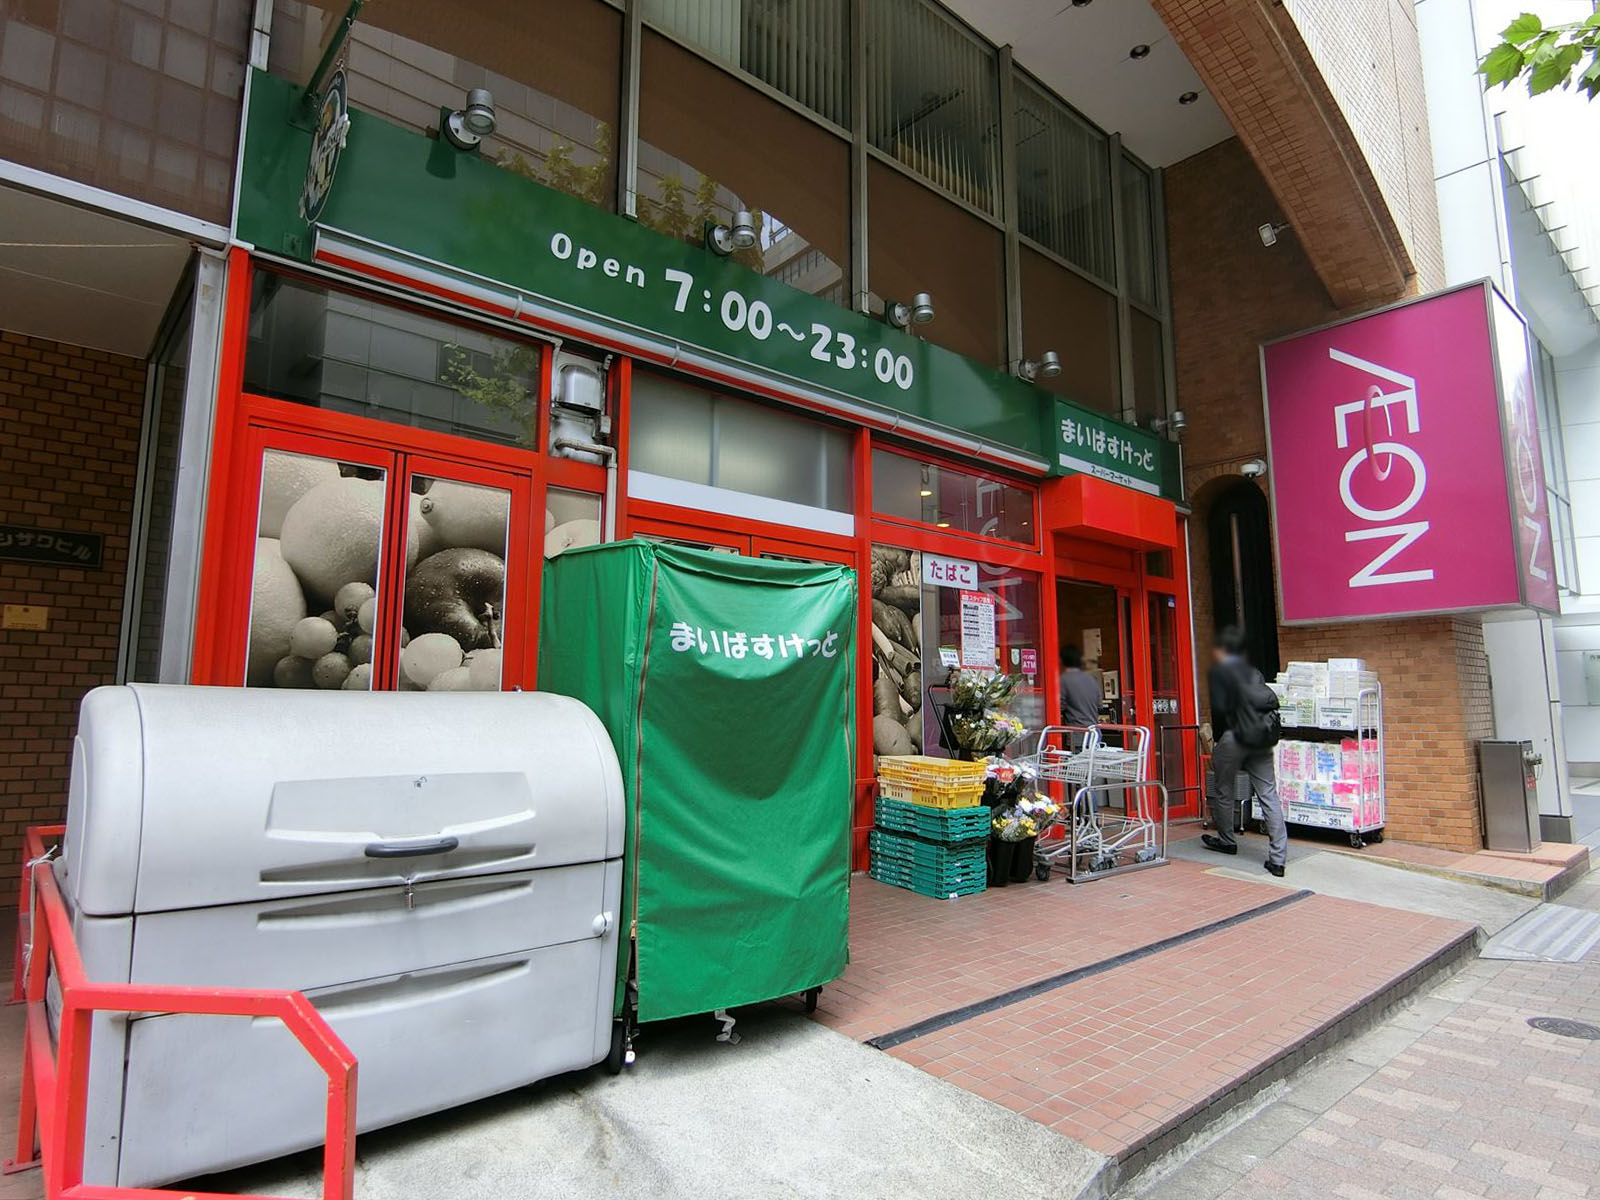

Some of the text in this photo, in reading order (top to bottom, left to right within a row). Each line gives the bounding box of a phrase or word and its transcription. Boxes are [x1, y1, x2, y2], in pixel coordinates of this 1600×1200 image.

[550, 232, 645, 289] Open
[1061, 418, 1155, 471] まいばすけっと
[1329, 347, 1434, 588] AEON
[931, 560, 971, 584] たばこ
[669, 621, 838, 660] まいばすけっと
